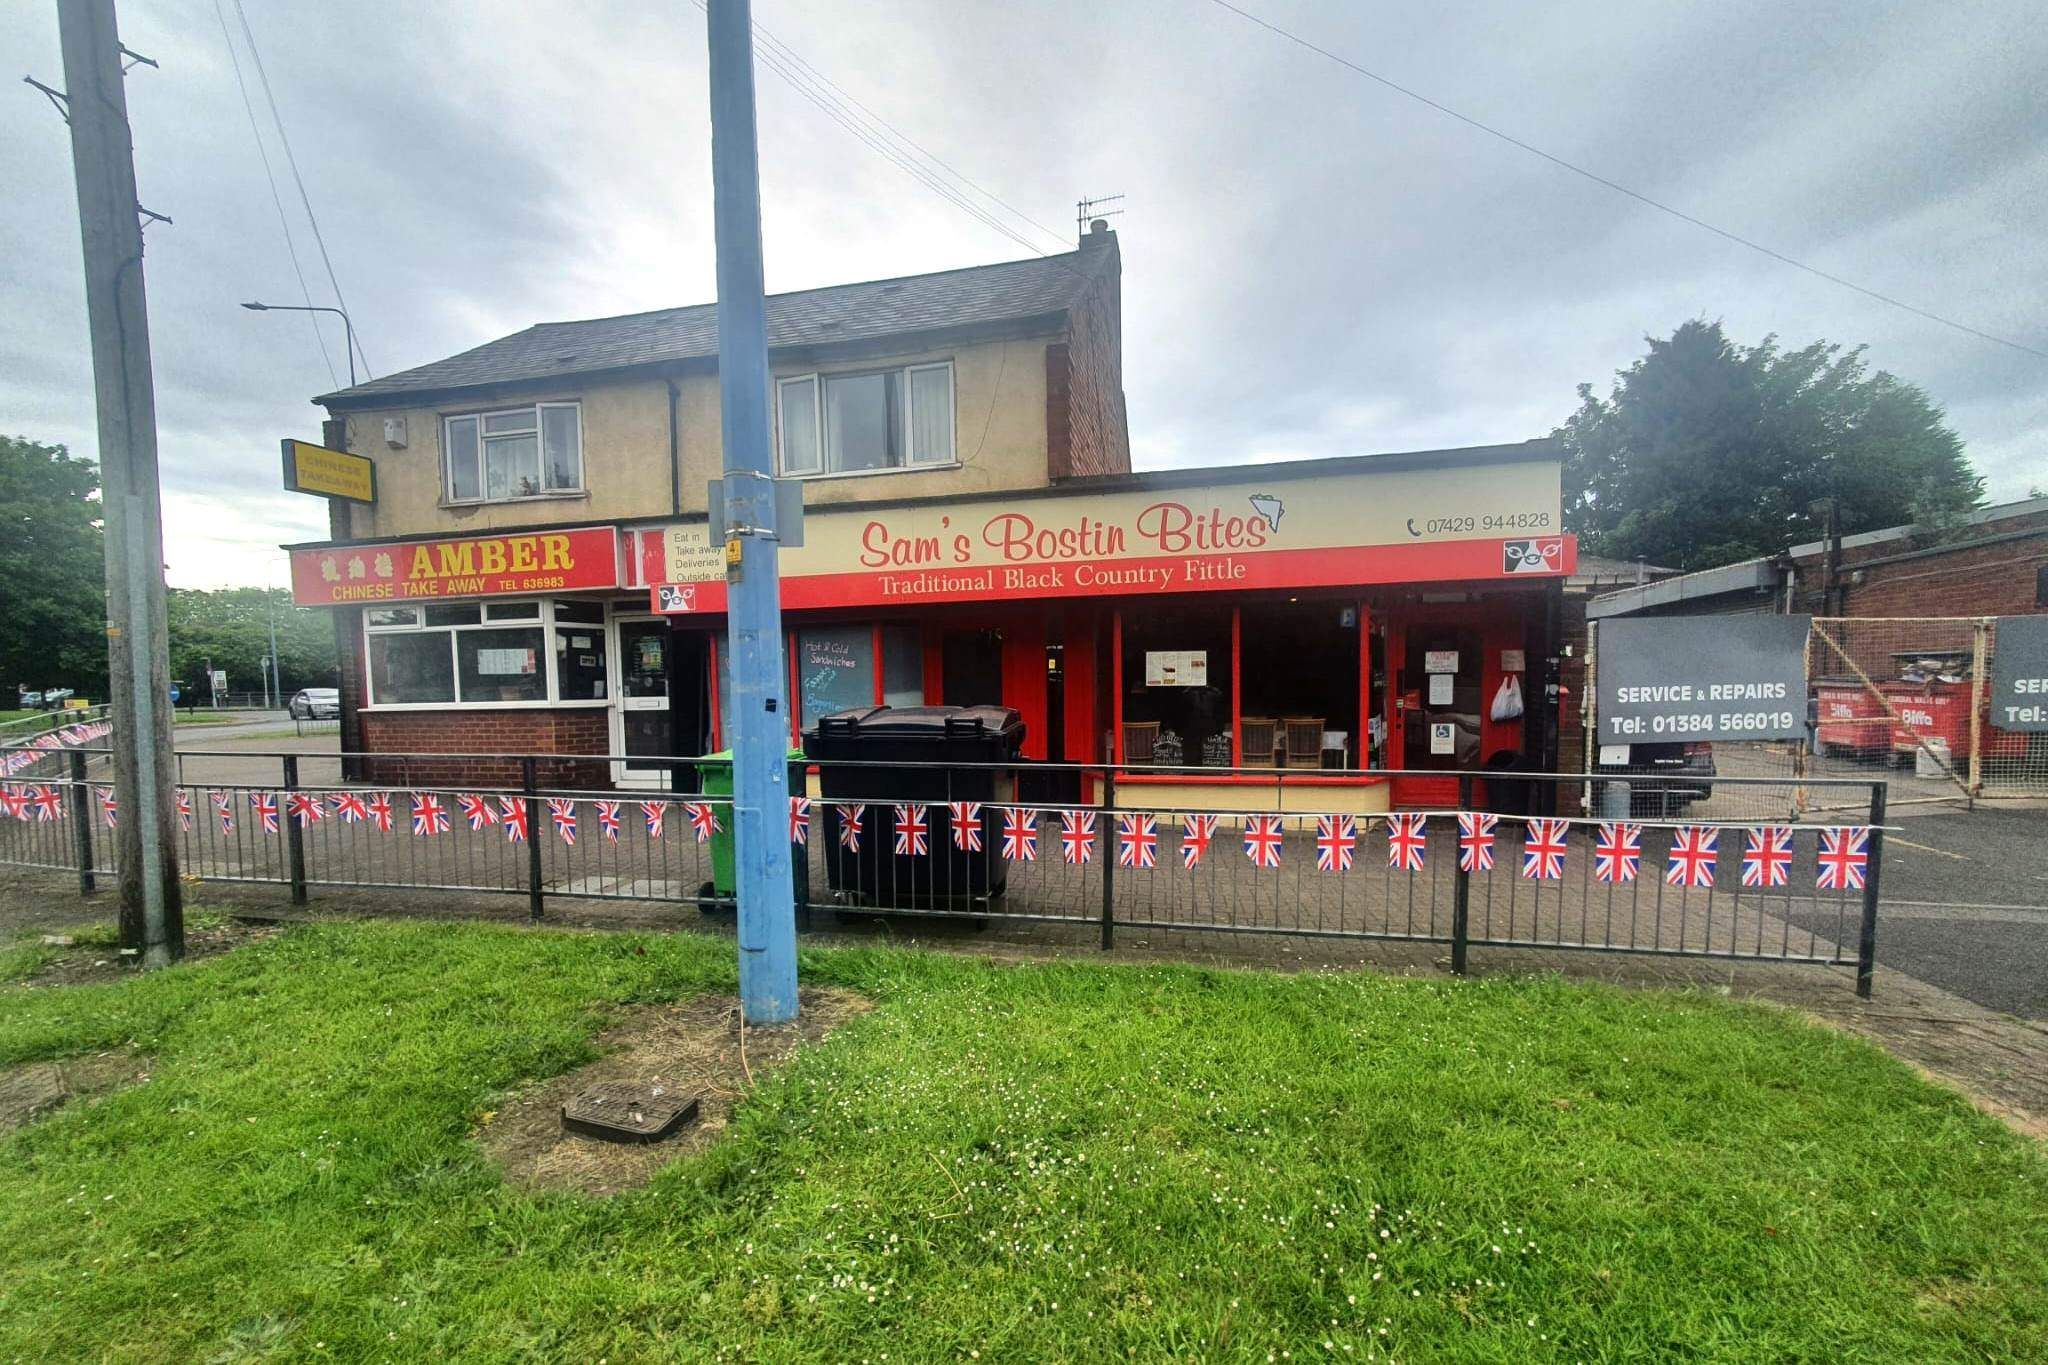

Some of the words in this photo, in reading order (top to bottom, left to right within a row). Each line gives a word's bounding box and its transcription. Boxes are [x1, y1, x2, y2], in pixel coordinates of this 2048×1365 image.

[1427, 517, 1475, 533] 07429
[1482, 512, 1550, 530] 944828
[674, 533, 688, 543] Eat
[860, 516, 970, 568] Sam's
[982, 513, 1127, 562] Bostin
[1136, 502, 1267, 553] Bites
[409, 534, 575, 580] AMBER
[676, 546, 695, 557] Take
[698, 545, 721, 556] away
[675, 557, 720, 569] Deliveries
[676, 570, 711, 583] Outside
[878, 569, 994, 597] Traditional
[1003, 567, 1064, 590] Black
[1074, 561, 1173, 591] Country
[1184, 558, 1247, 581] Fittle
[332, 583, 394, 600] CHINESE
[400, 580, 438, 597] TAKE
[447, 577, 486, 594] AWAY
[499, 579, 518, 591] TEL
[831, 641, 849, 654] Cold
[810, 652, 856, 668] Sandwiches
[1617, 685, 1692, 703] SERVICE
[1696, 689, 1705, 701] &
[1710, 682, 1786, 700] REPAIRS
[1611, 716, 1647, 734] Tel:
[1652, 714, 1714, 733] 01384
[1719, 711, 1794, 731] 566019
